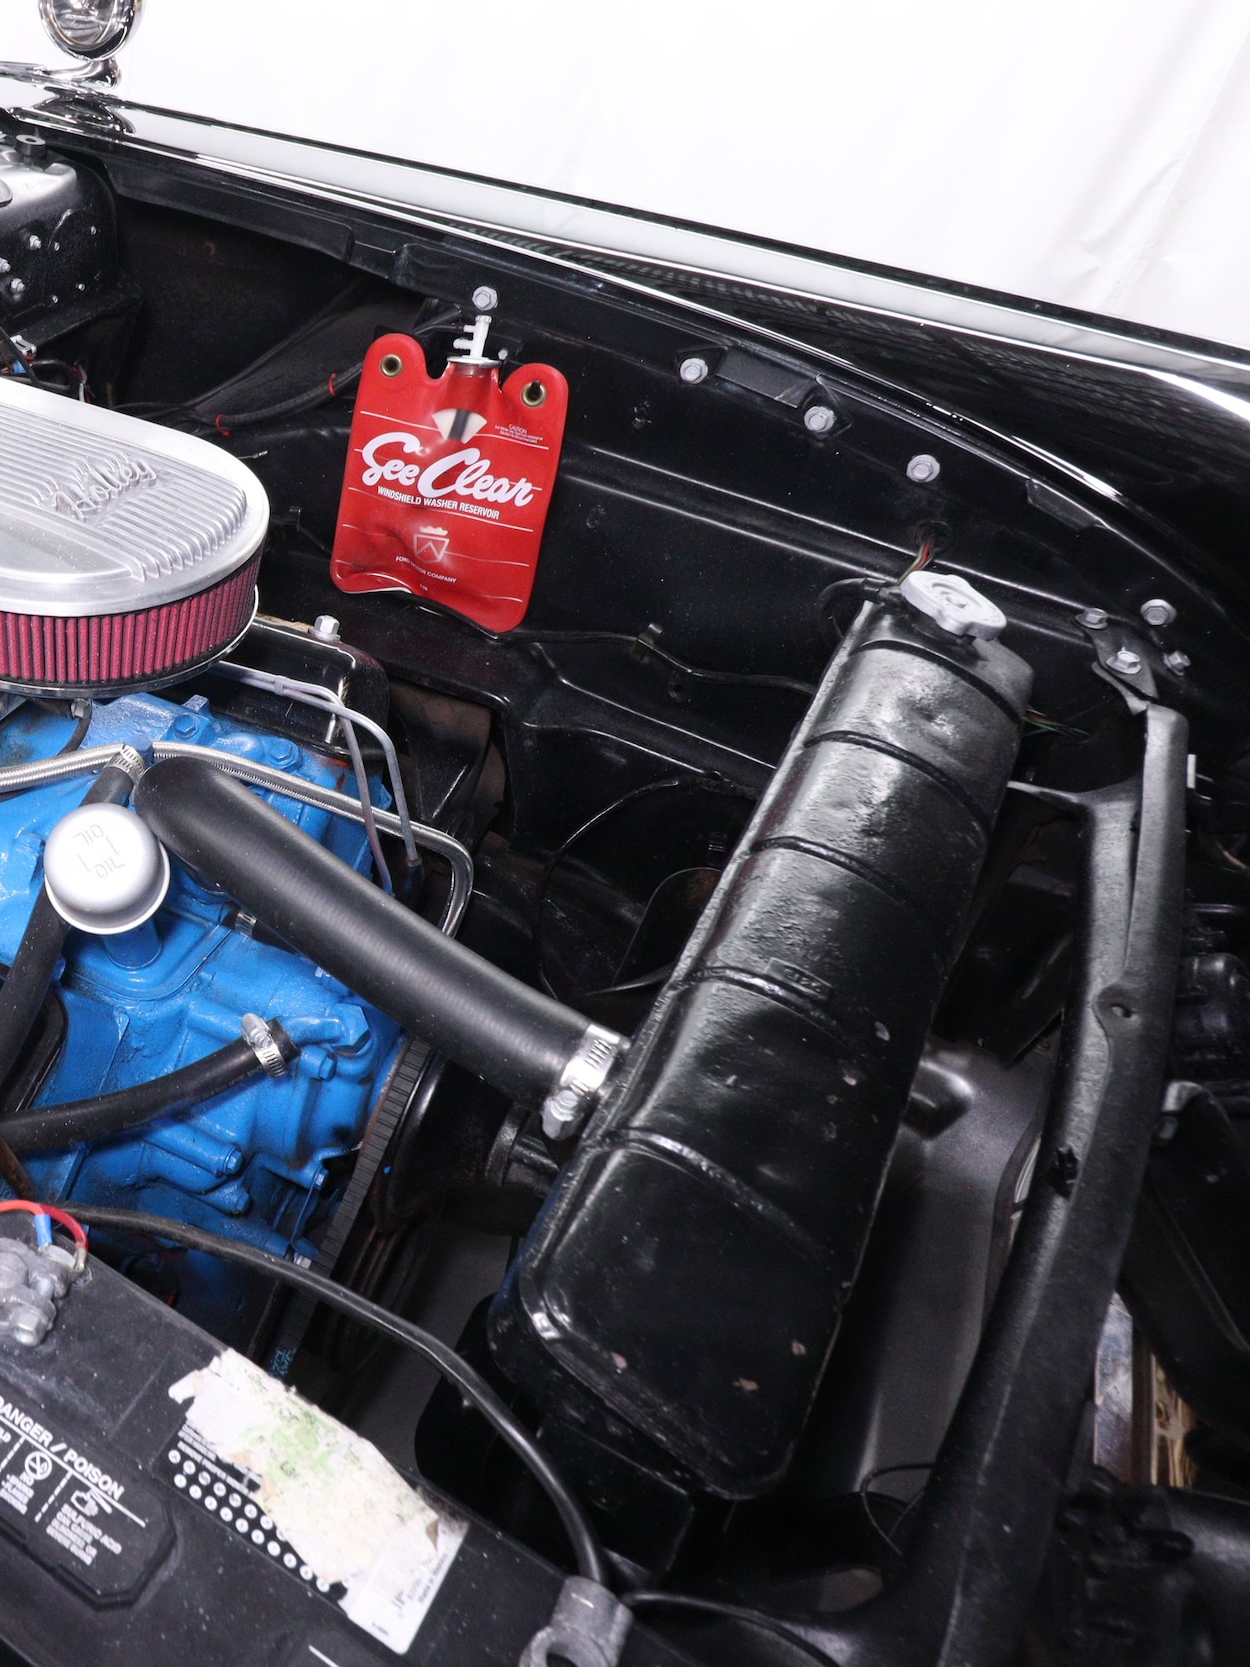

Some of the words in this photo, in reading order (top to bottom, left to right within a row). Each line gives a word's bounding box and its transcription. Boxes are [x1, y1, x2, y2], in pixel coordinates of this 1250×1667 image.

[51, 460, 158, 521] Holley
[362, 432, 420, 486] See
[417, 448, 534, 507] Clear
[377, 486, 421, 505] WINDSHIELD
[423, 497, 458, 511] WASHER
[459, 503, 500, 519] RESERVOIR
[427, 571, 457, 583] COMPANY
[94, 857, 125, 880] OIL
[63, 1447, 125, 1501] POISON
